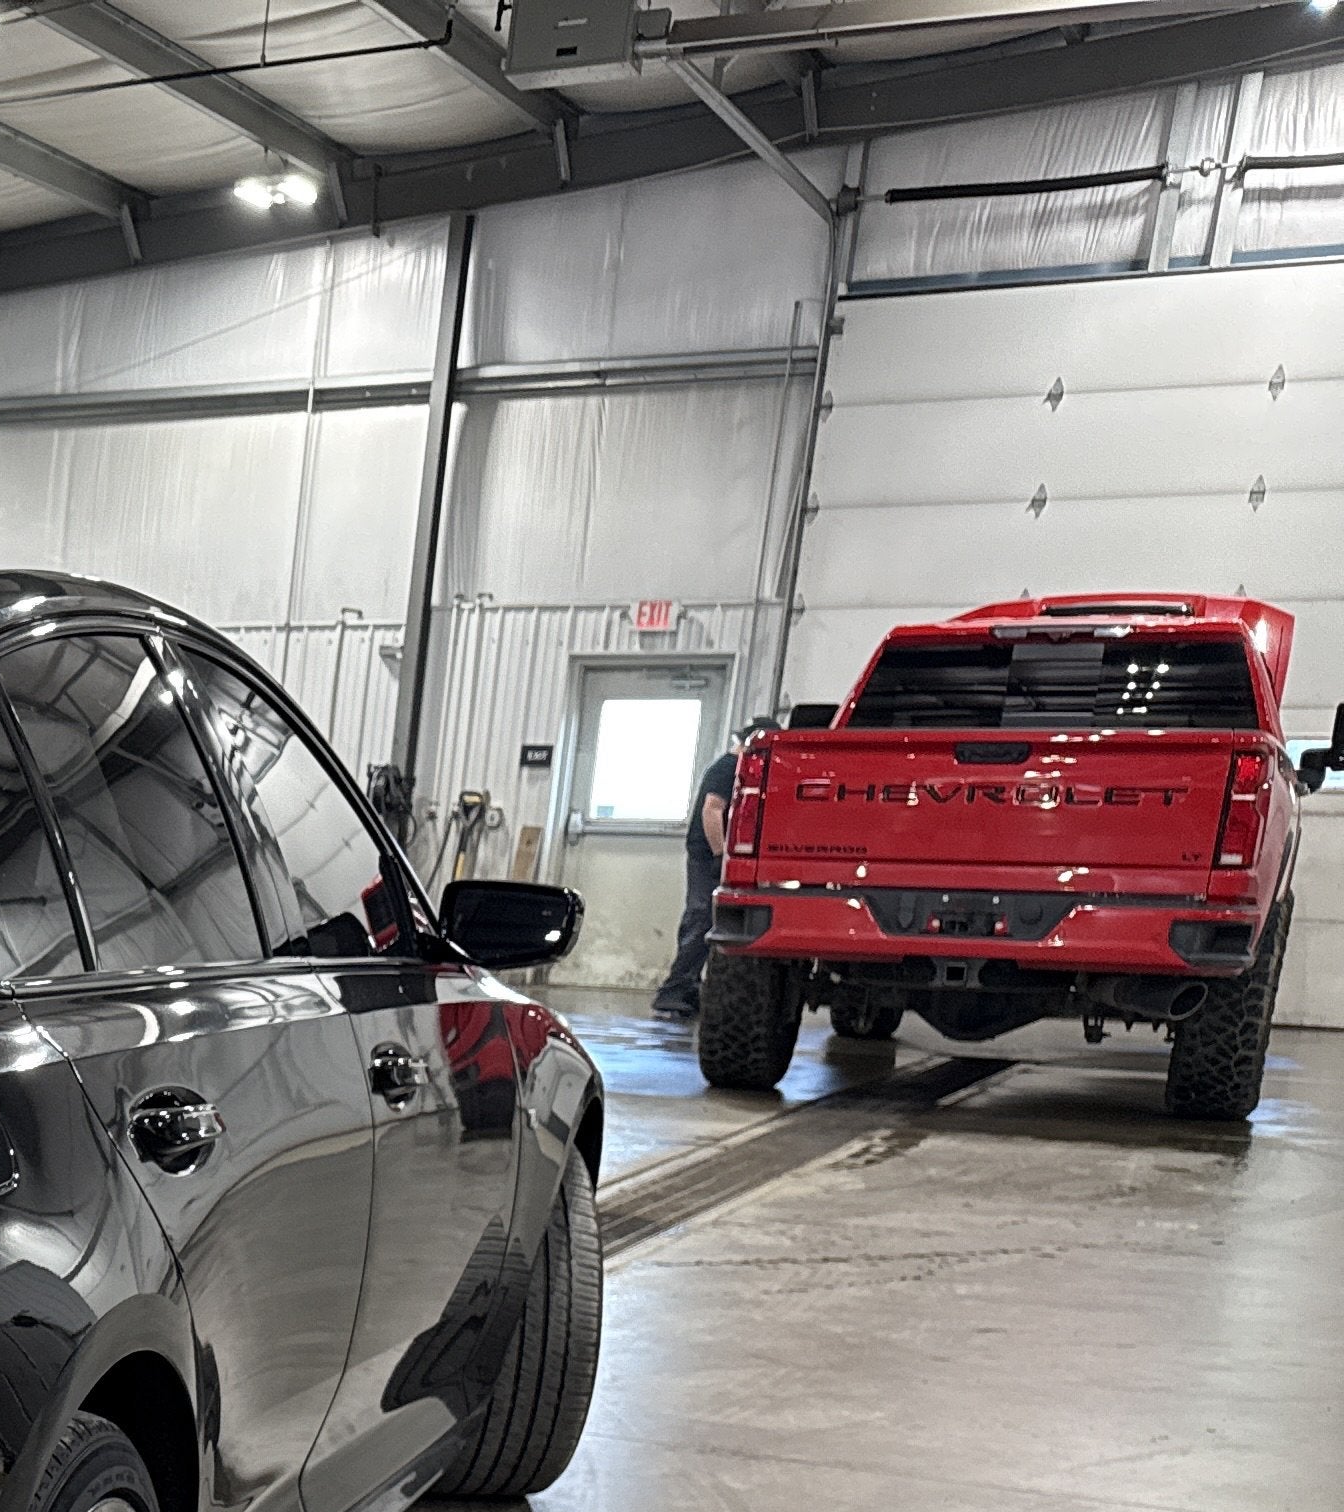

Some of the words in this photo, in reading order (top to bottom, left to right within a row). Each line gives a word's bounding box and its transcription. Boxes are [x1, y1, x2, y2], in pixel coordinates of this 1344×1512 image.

[636, 600, 673, 631] EXIT
[795, 781, 1191, 807] CHEVROLET
[767, 844, 868, 855] SILVERADO
